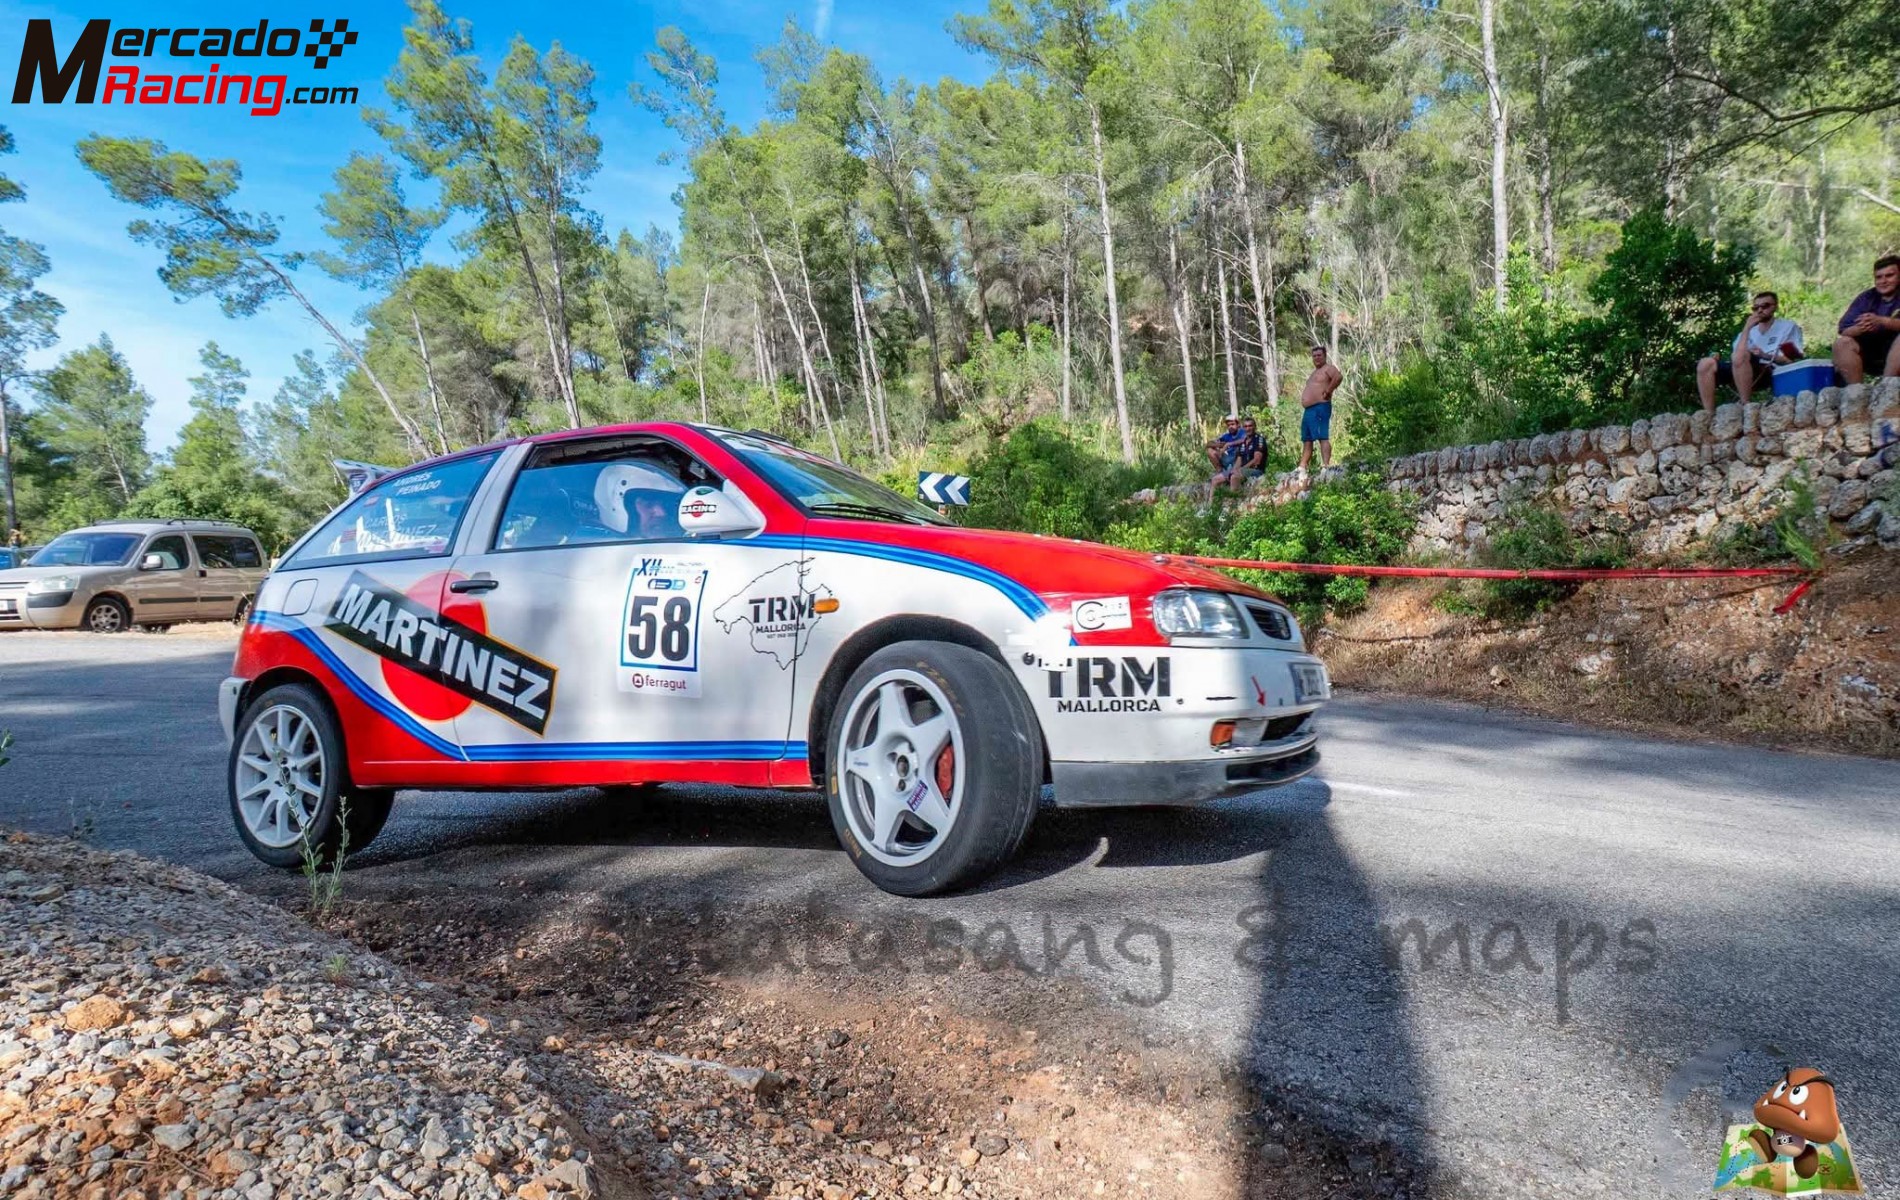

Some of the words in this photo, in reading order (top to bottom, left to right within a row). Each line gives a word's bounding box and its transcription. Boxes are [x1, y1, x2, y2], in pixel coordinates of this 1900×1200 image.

[748, 593, 816, 623] TRM
[628, 595, 691, 662] 58
[755, 622, 807, 634] MALLORCA
[335, 583, 550, 720] MARTINEZ
[645, 674, 687, 691] ferragut
[1038, 656, 1171, 698] TRM
[1057, 699, 1161, 712] MALLORCA
